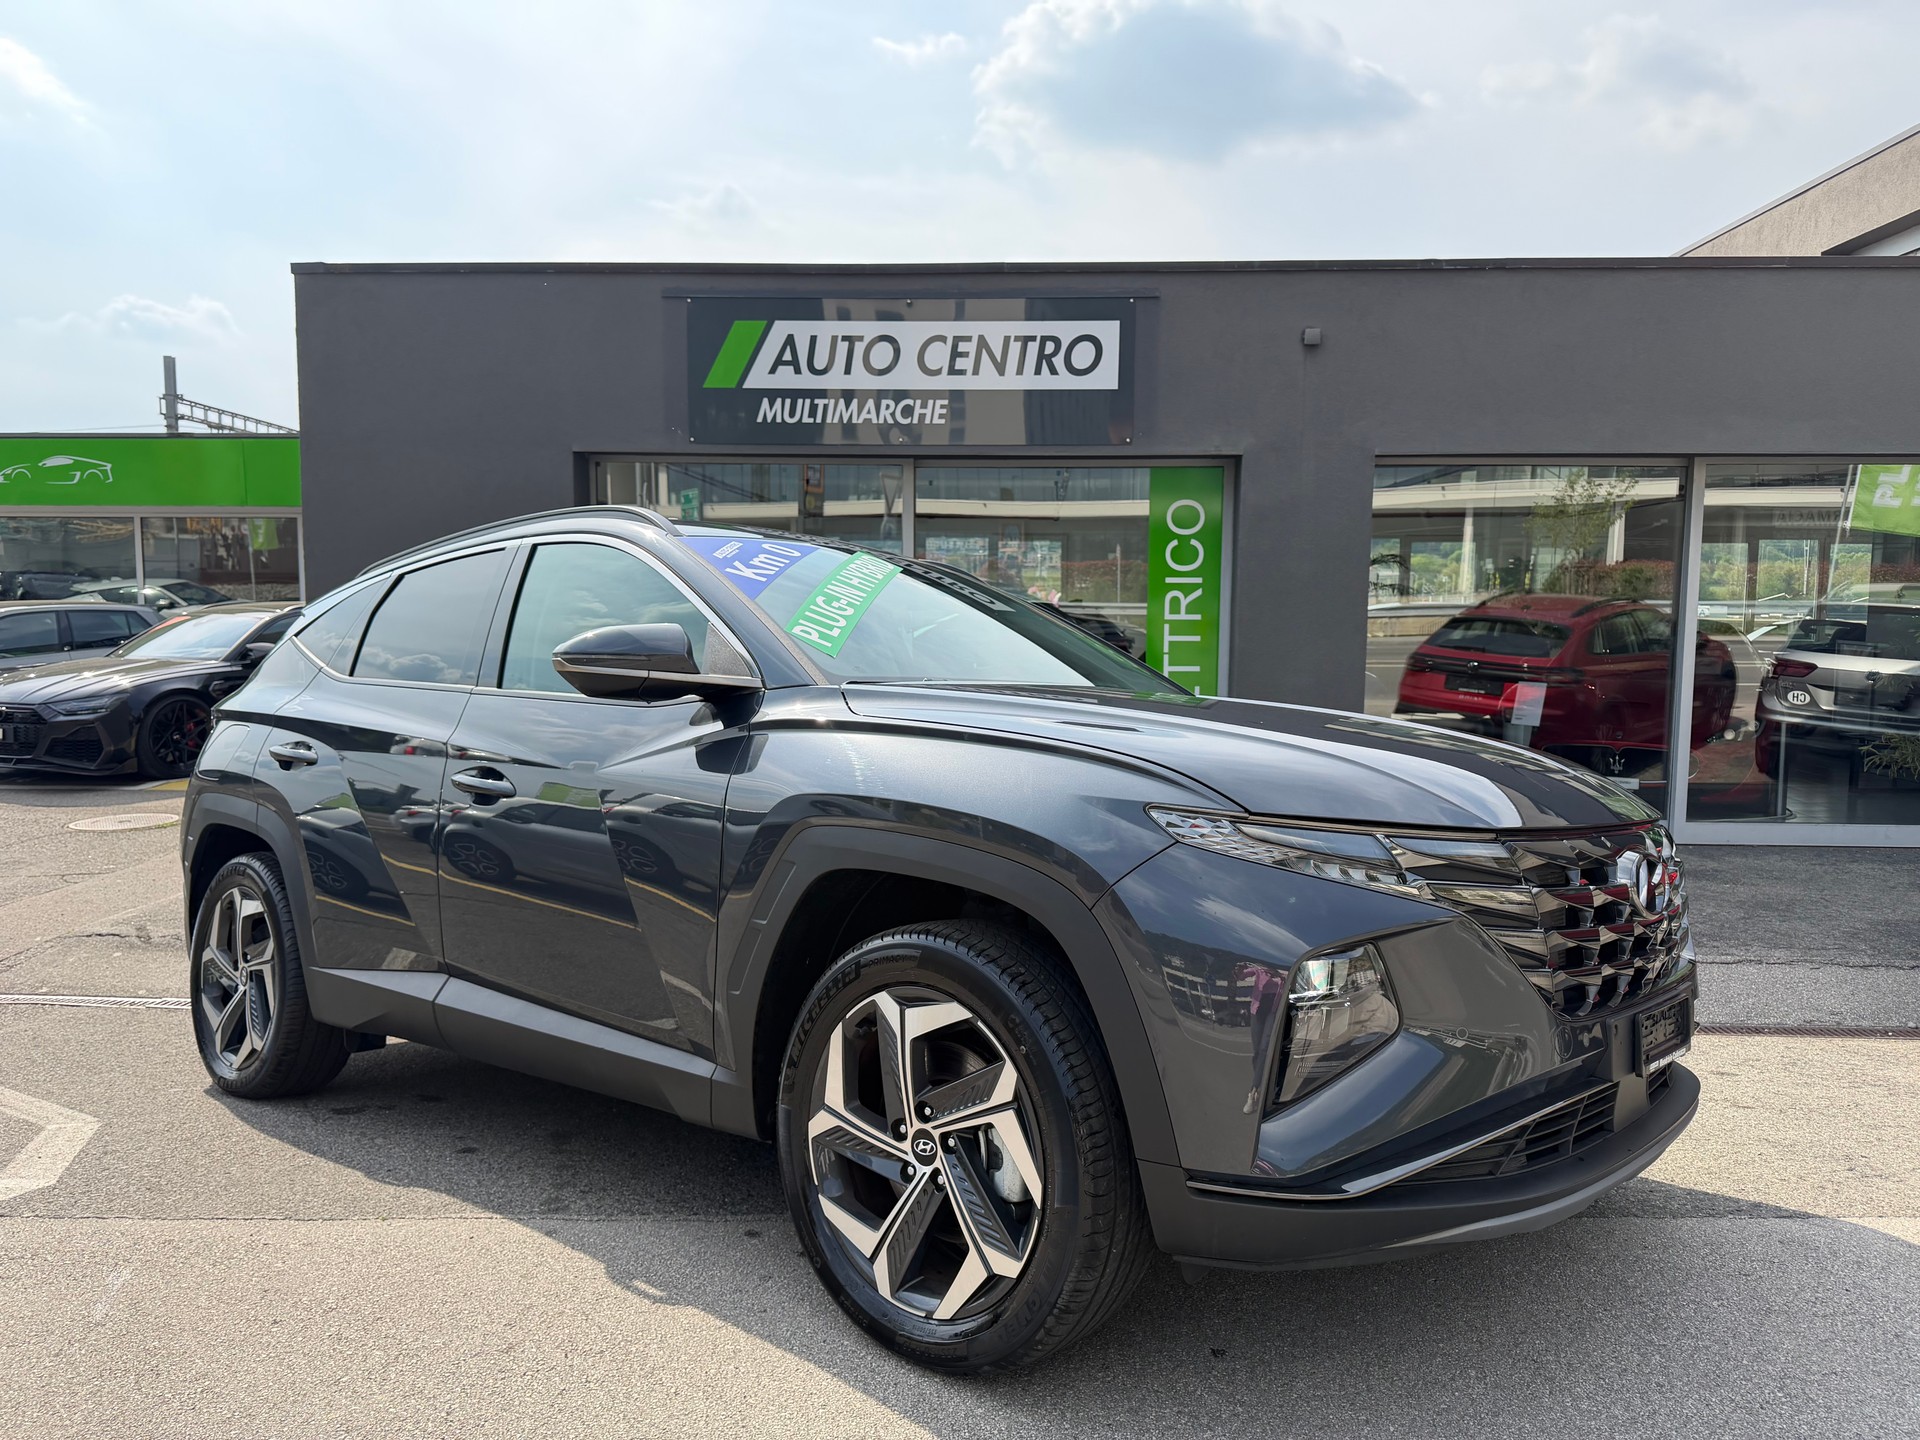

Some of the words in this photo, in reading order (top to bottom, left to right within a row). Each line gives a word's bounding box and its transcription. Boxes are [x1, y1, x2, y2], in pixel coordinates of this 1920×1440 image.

[767, 333, 901, 377] AUTO
[916, 333, 1104, 378] CENTRO
[756, 396, 949, 425] MULTIMARCHE
[725, 554, 790, 582] Km
[761, 543, 802, 557] 0
[791, 580, 868, 647] PLUG-IN
[836, 555, 895, 592] HYBRID
[1163, 499, 1206, 696] TTRICO
